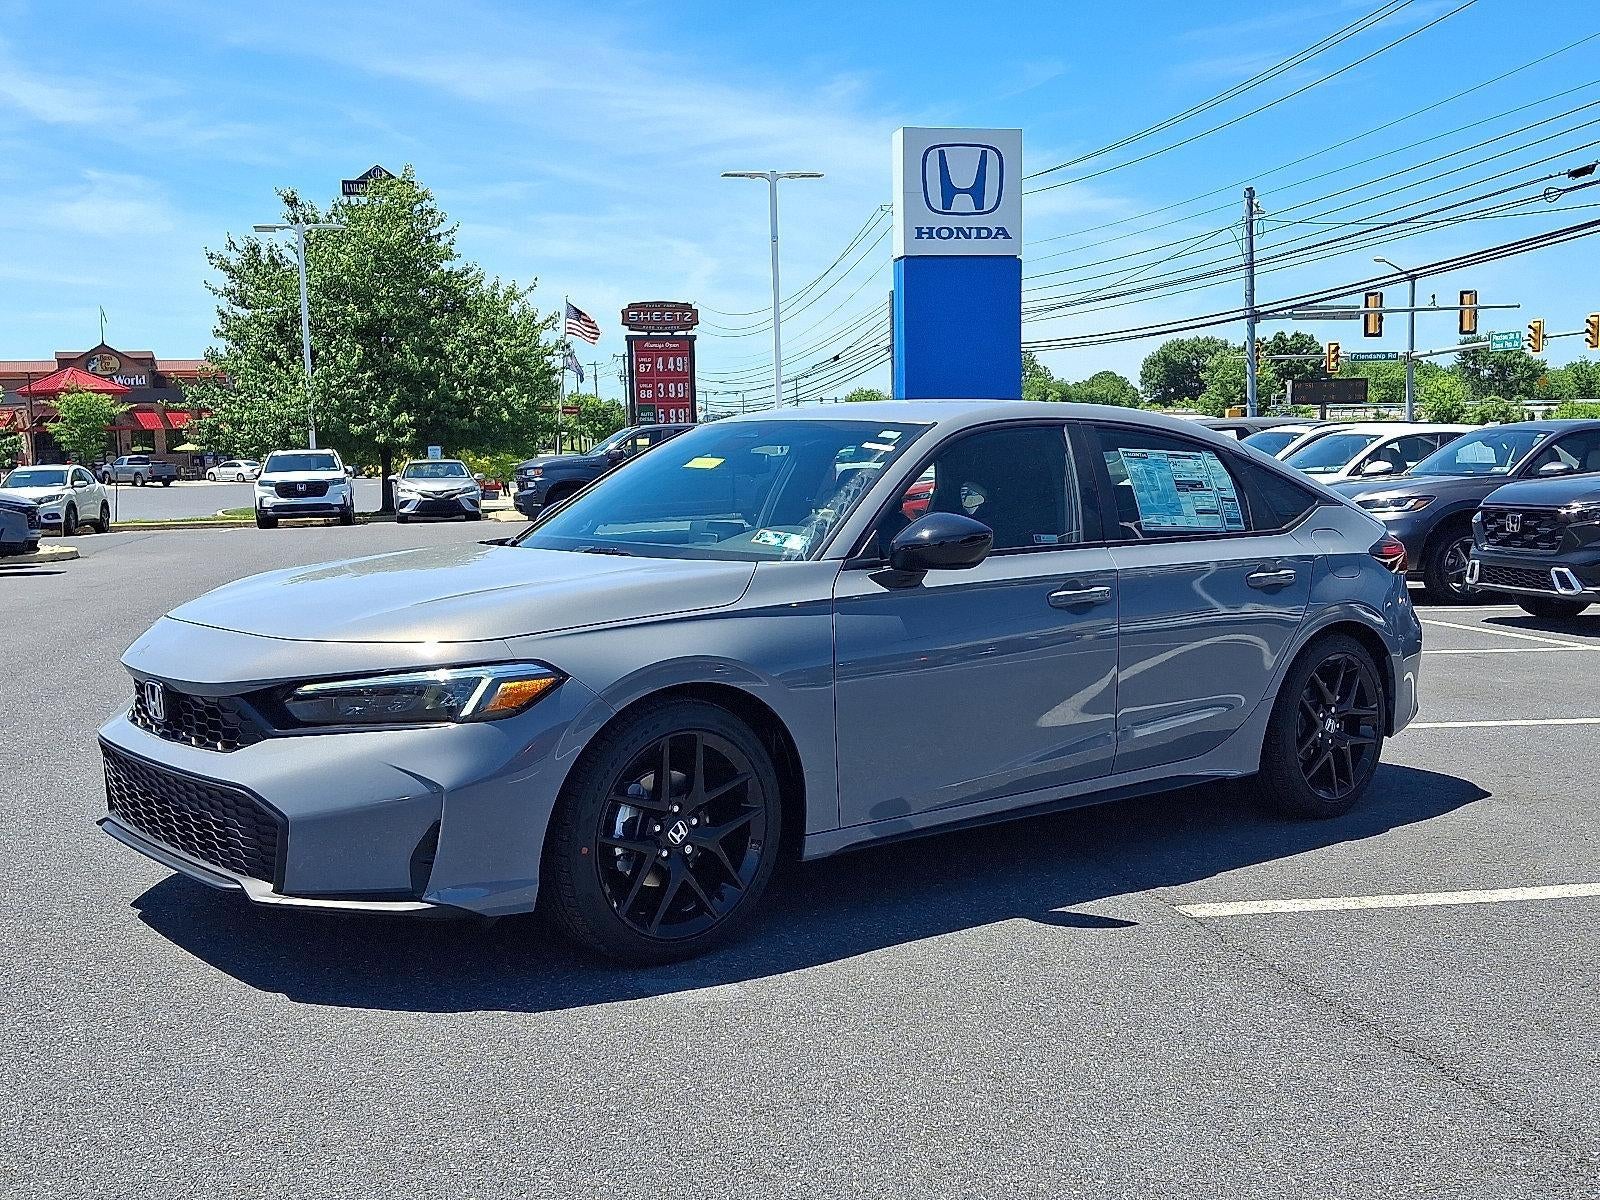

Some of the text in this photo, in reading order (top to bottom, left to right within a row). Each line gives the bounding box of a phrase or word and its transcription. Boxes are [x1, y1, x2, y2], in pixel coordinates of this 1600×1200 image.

[914, 226, 1013, 241] HONDA
[628, 311, 693, 321] SHEETZ
[639, 363, 652, 373] 87
[657, 356, 683, 372] 4.49
[113, 375, 146, 385] World
[640, 389, 653, 399] 88
[658, 382, 684, 398] 3.99
[658, 408, 685, 423] 5.99
